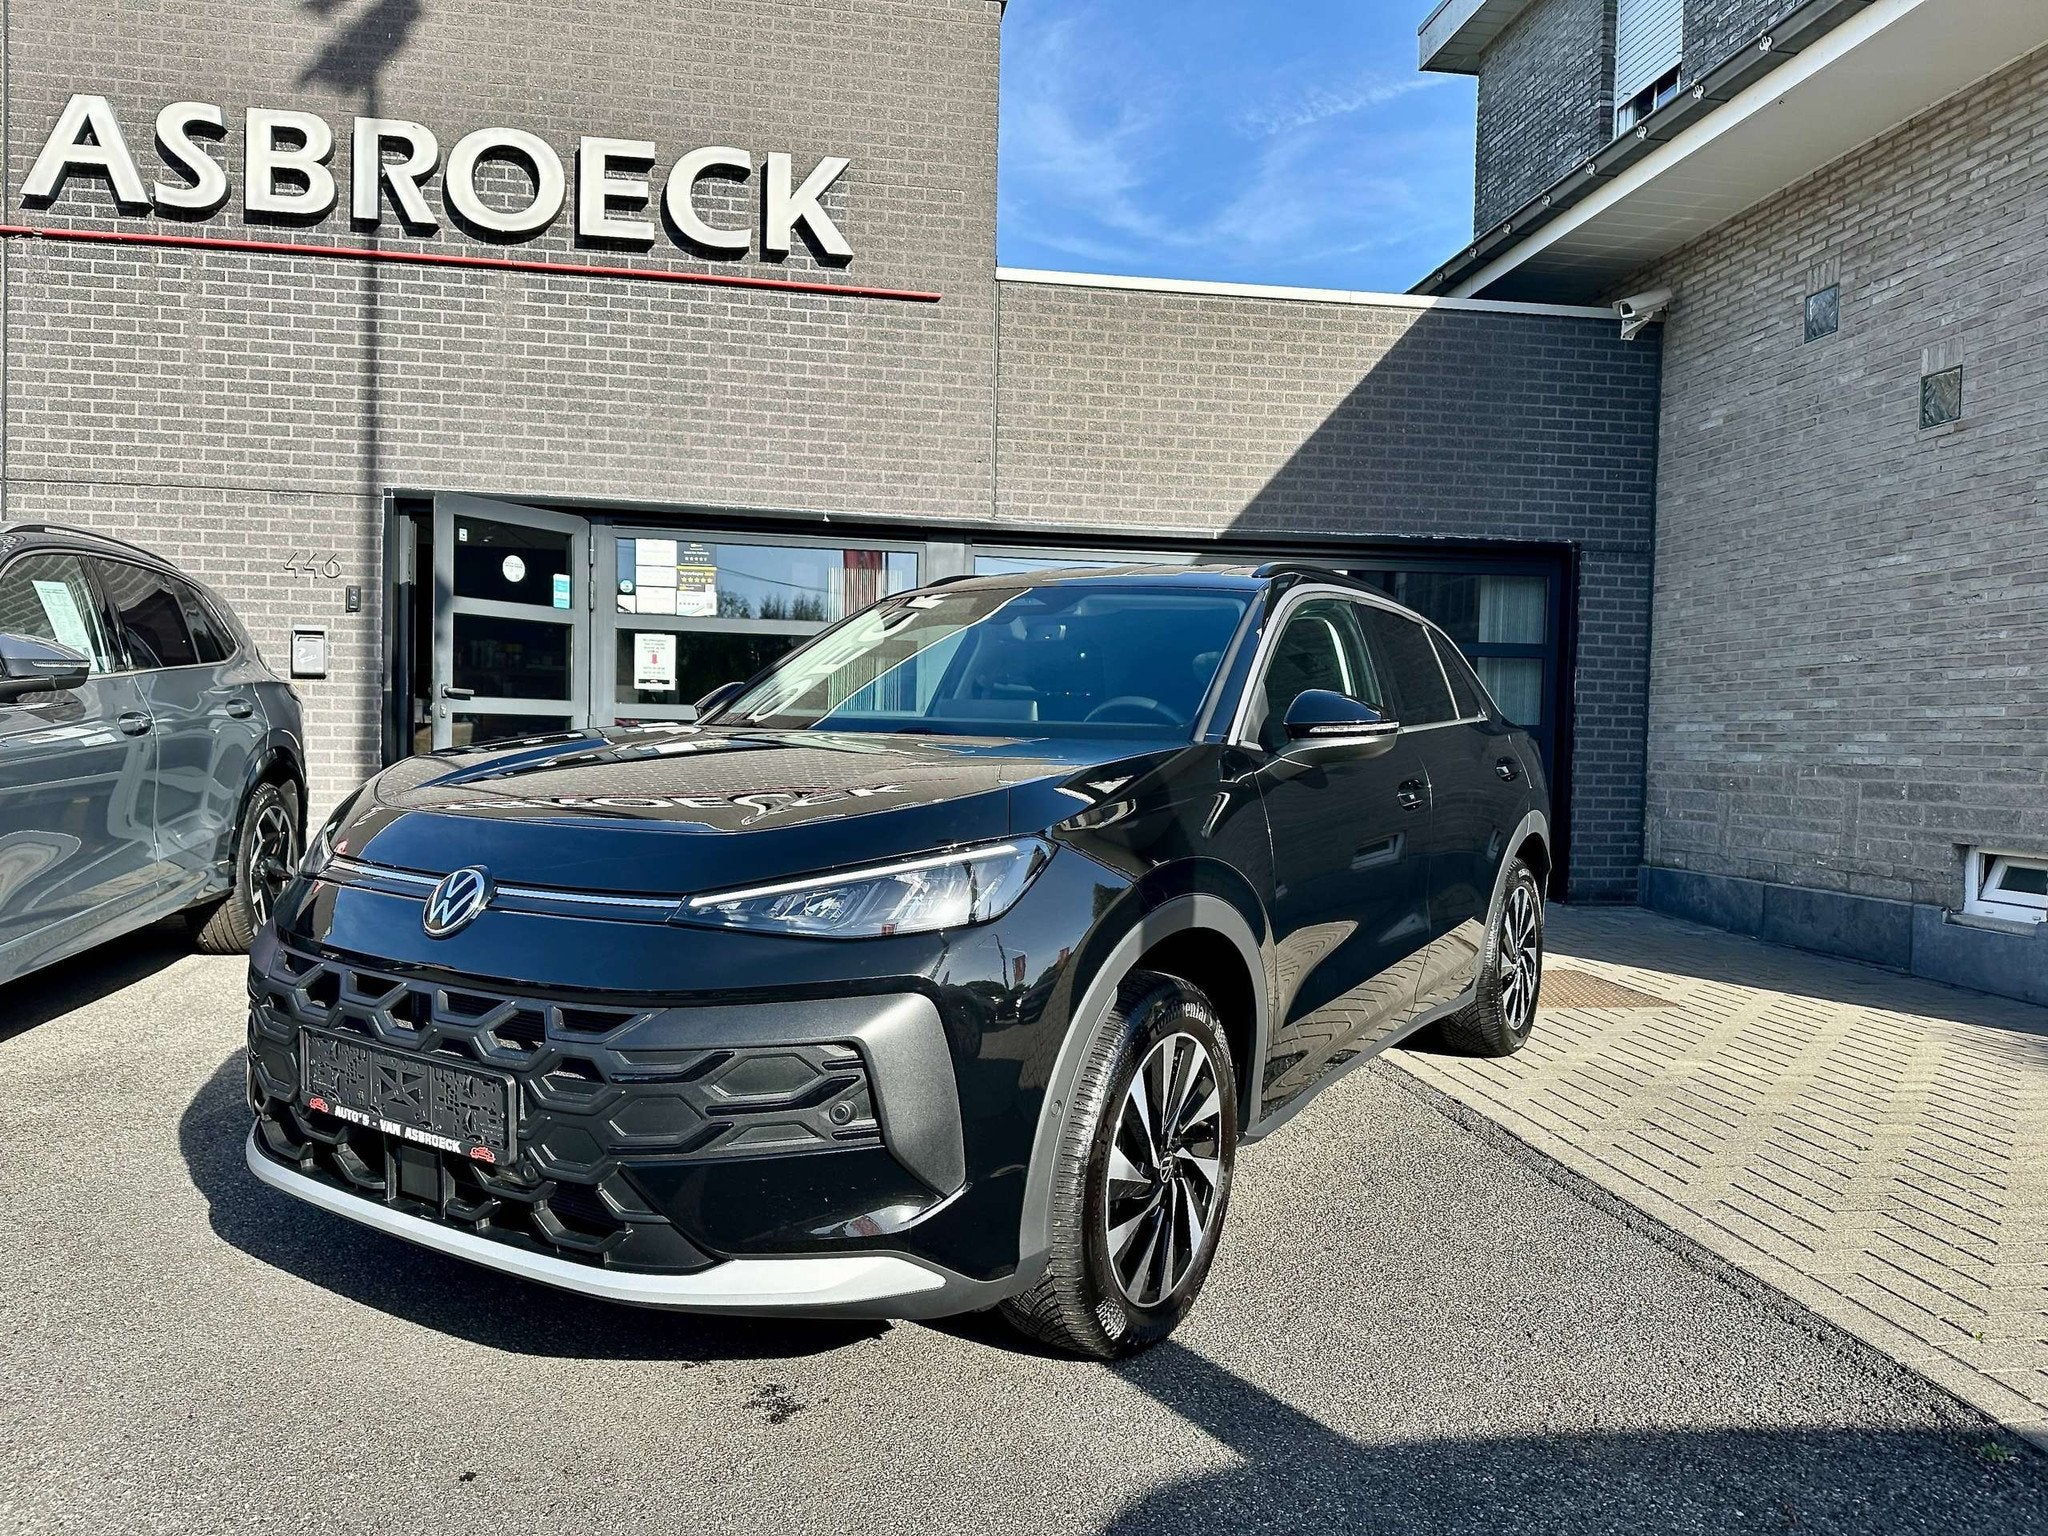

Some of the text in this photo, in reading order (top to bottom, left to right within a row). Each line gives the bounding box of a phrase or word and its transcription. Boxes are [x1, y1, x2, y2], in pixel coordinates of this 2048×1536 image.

[20, 94, 854, 262] ASBROECK
[284, 552, 342, 579] 446
[335, 1105, 370, 1126] AUTO'S
[380, 1119, 401, 1136] VAN
[404, 1127, 462, 1154] ASBROECK
